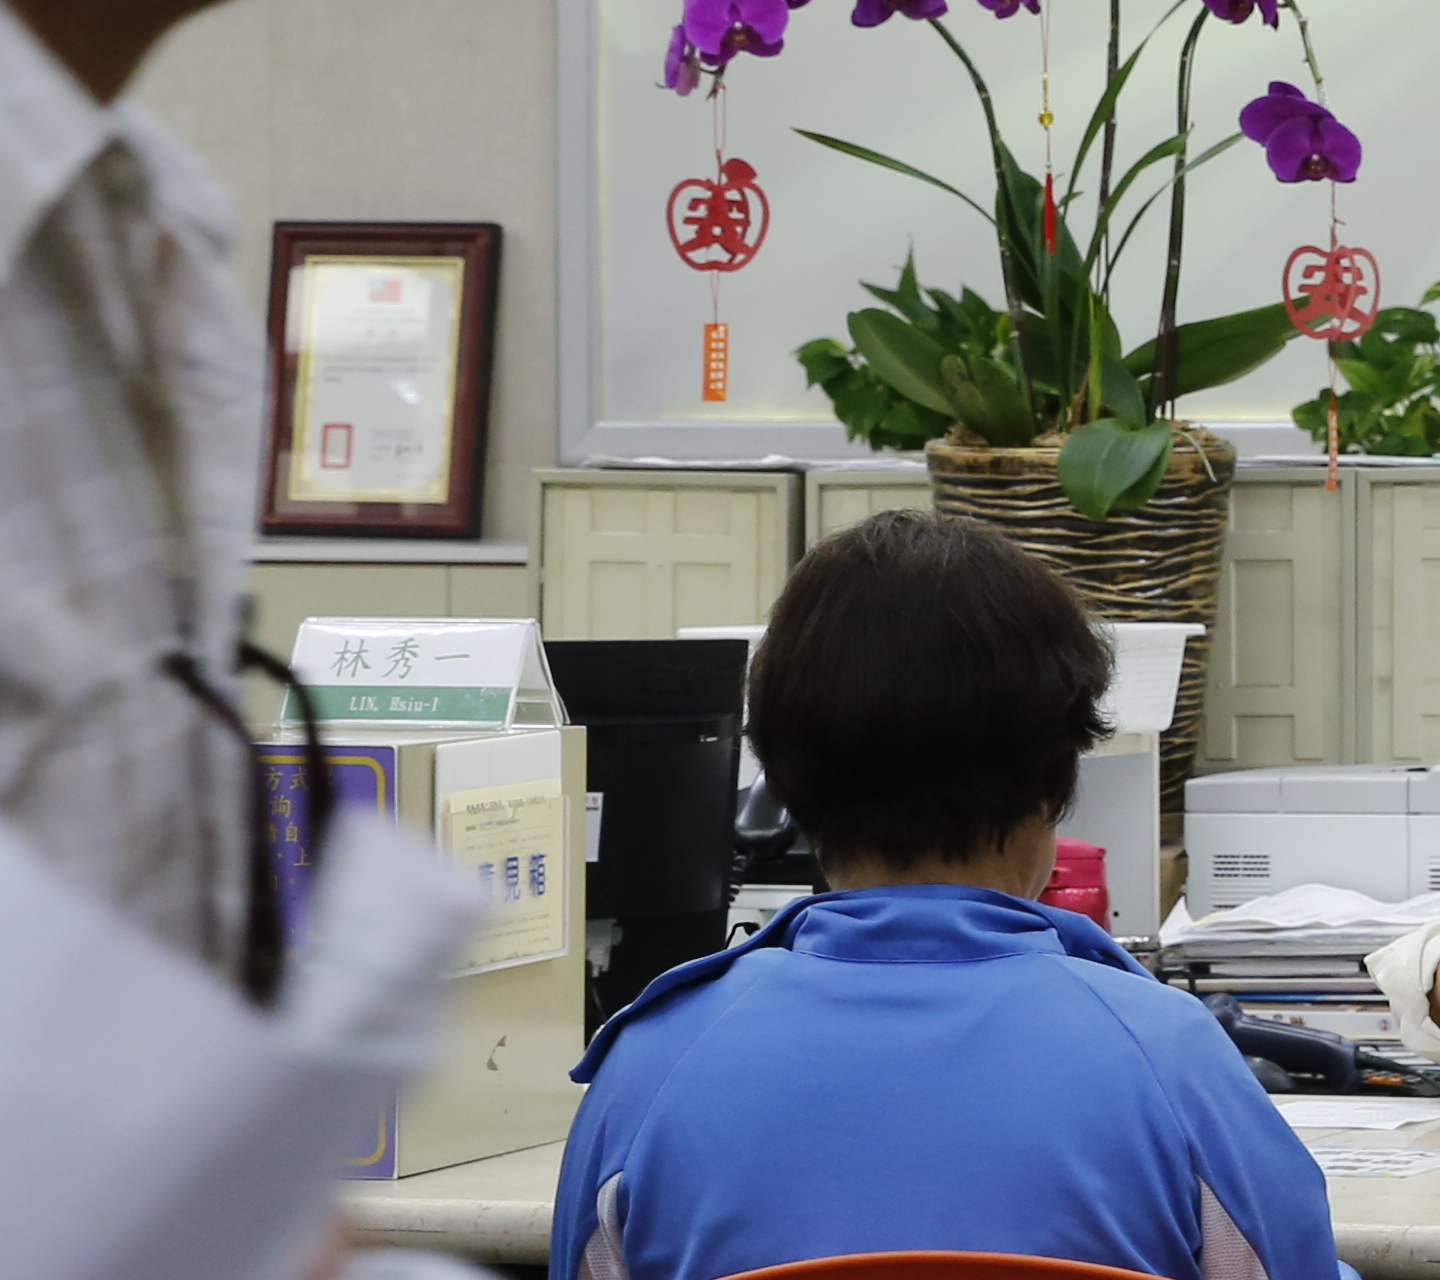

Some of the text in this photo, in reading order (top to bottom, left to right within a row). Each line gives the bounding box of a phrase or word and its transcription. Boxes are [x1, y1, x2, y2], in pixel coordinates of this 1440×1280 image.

[329, 637, 470, 679] 林秀一
[349, 696, 379, 712] LIN,
